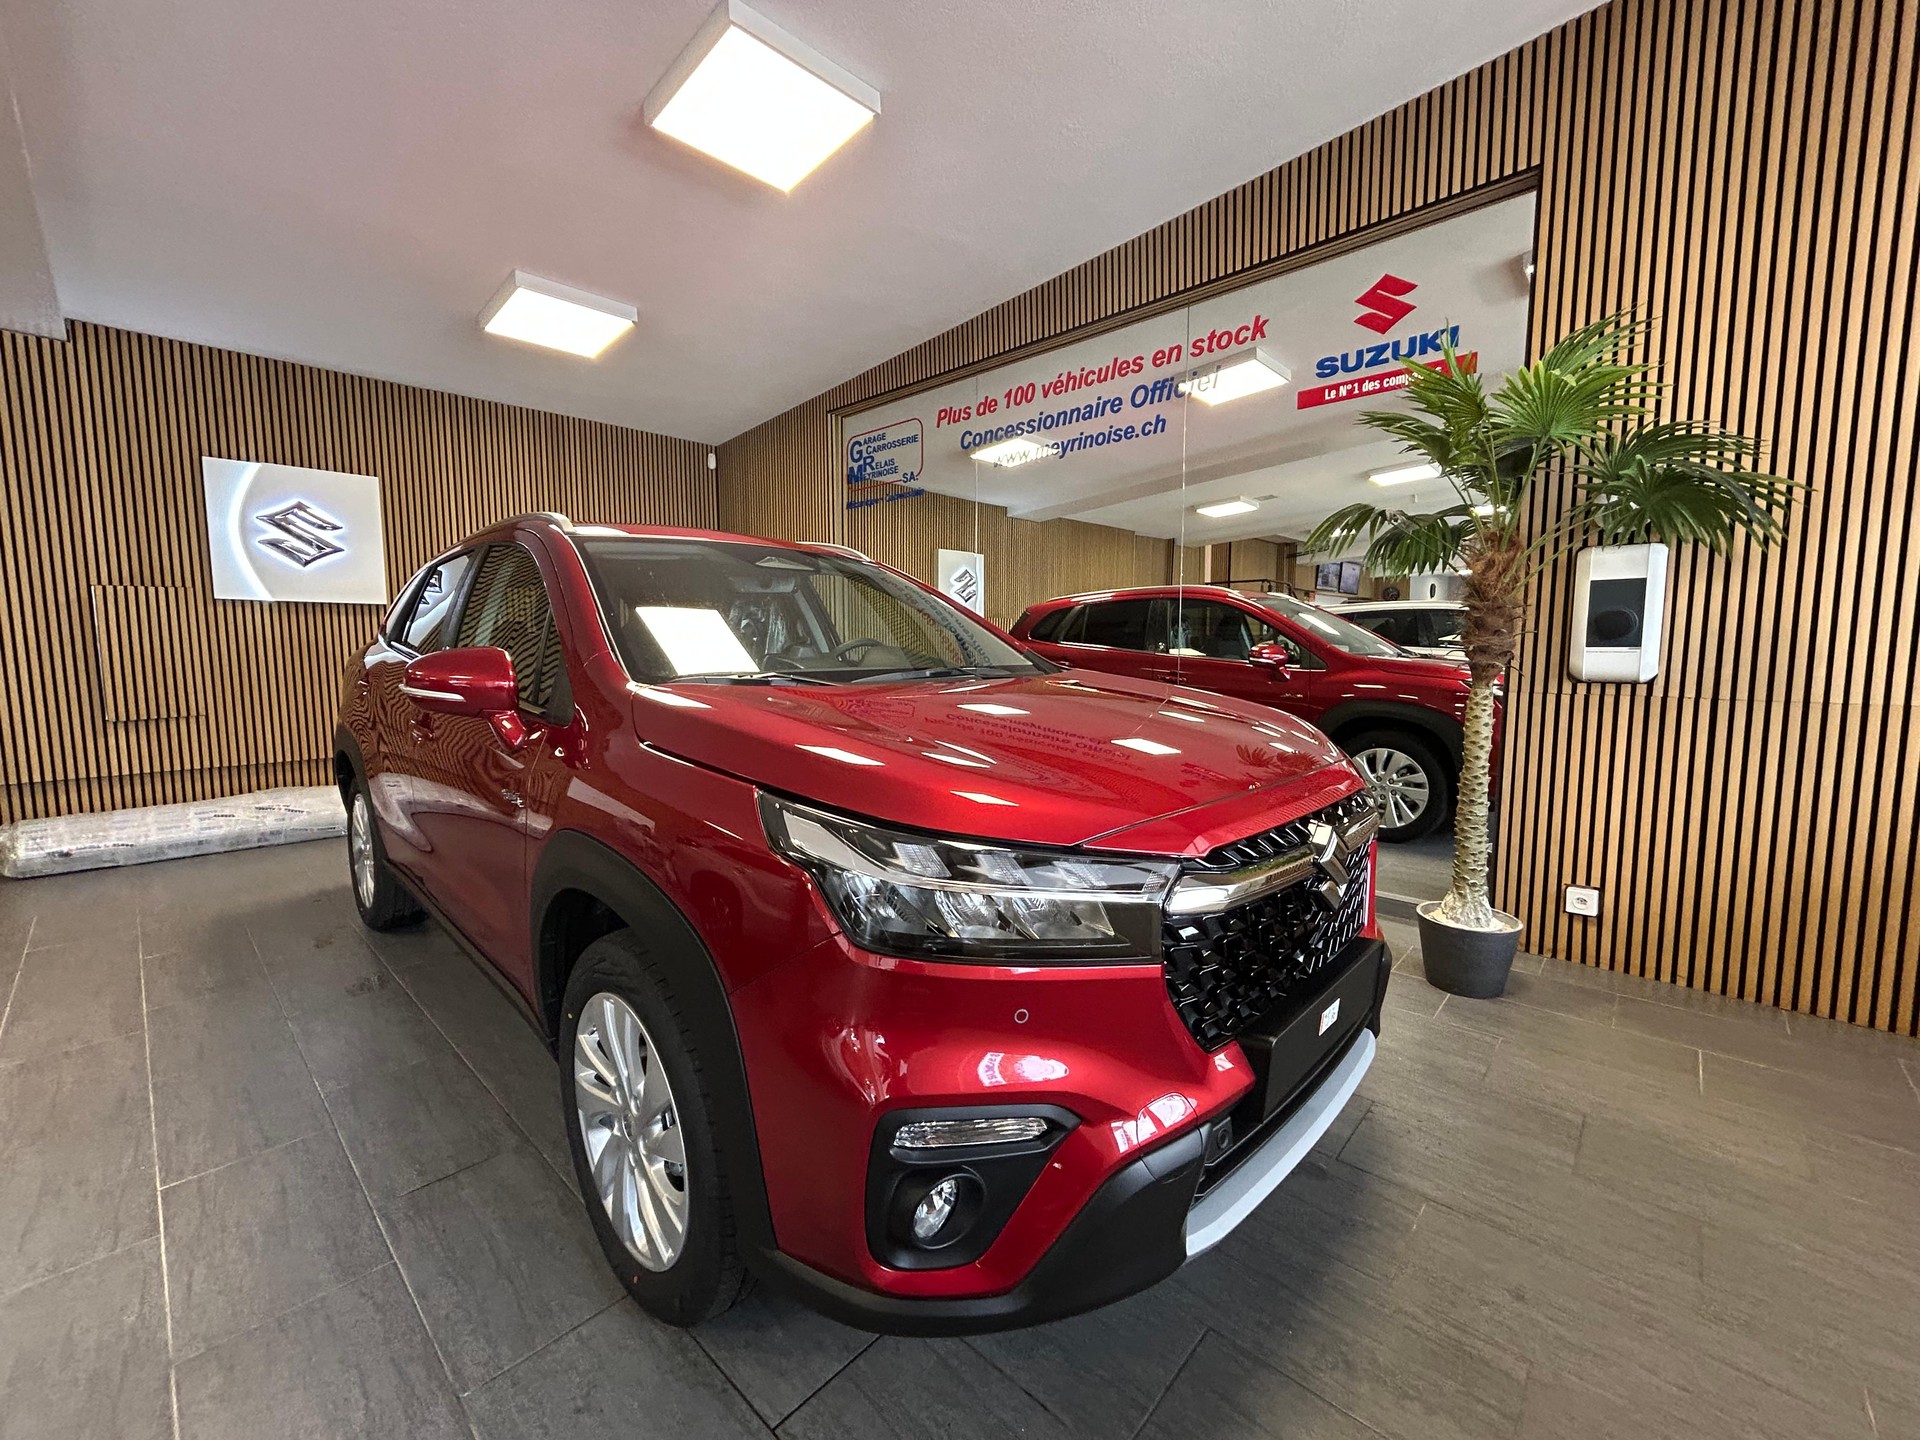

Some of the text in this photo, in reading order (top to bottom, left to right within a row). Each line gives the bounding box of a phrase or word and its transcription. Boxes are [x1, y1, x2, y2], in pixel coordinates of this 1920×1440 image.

[1315, 325, 1460, 379] SUZUKI
[936, 314, 1270, 428] Plus de 100 véhicules en stock
[1324, 388, 1336, 401] Le
[1362, 380, 1381, 393] des
[960, 364, 1222, 450] Concessionnaire Officiel
[850, 432, 886, 463] GARAGE
[866, 434, 919, 455] CARROSSERIE
[848, 464, 899, 484] MEYRINOISE
[863, 455, 895, 472] RELAIS
